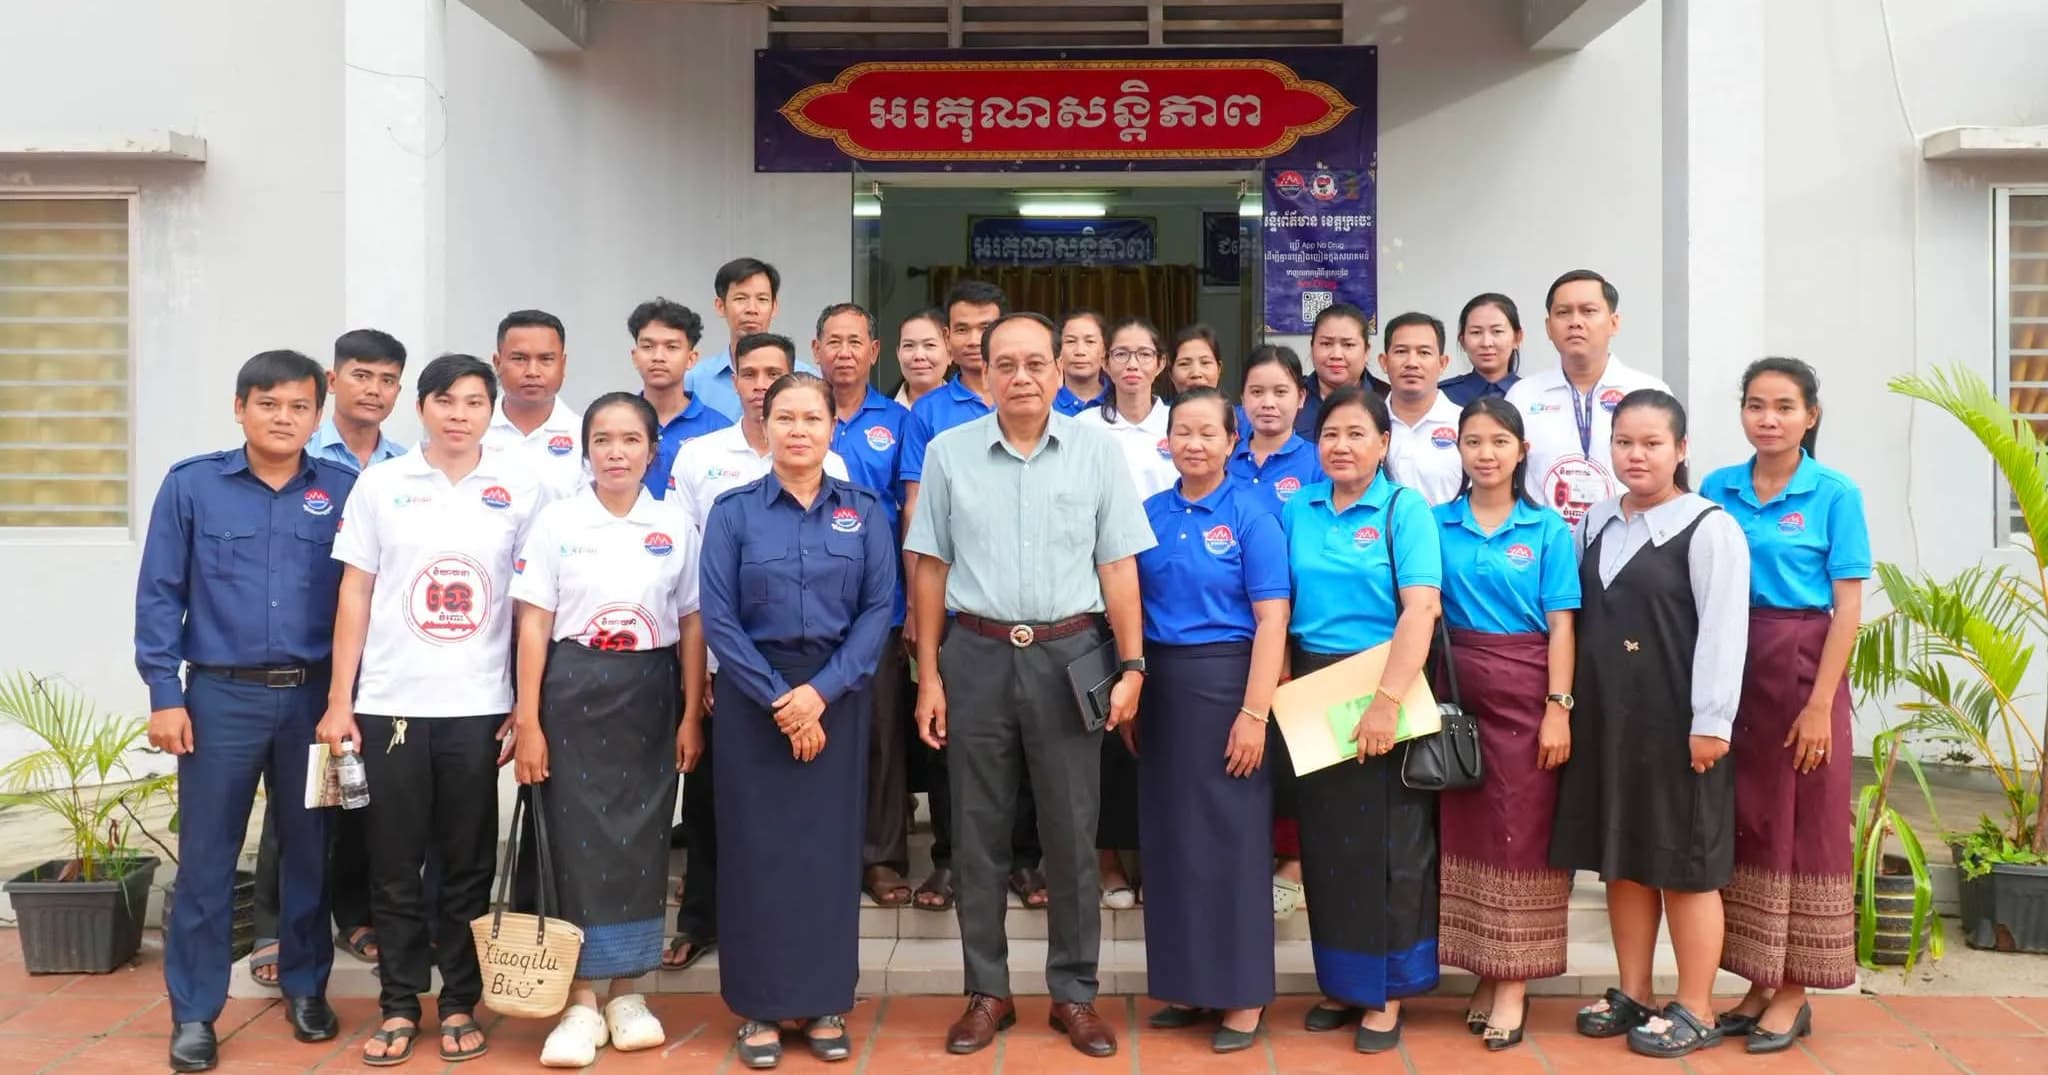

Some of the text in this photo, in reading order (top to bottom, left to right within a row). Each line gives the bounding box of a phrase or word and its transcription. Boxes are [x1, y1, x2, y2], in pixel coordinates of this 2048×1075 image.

[869, 80, 1261, 142] អរគុណសន្តិភាព
[484, 939, 560, 975] Xiaoqilu
[491, 972, 513, 996] Bi
